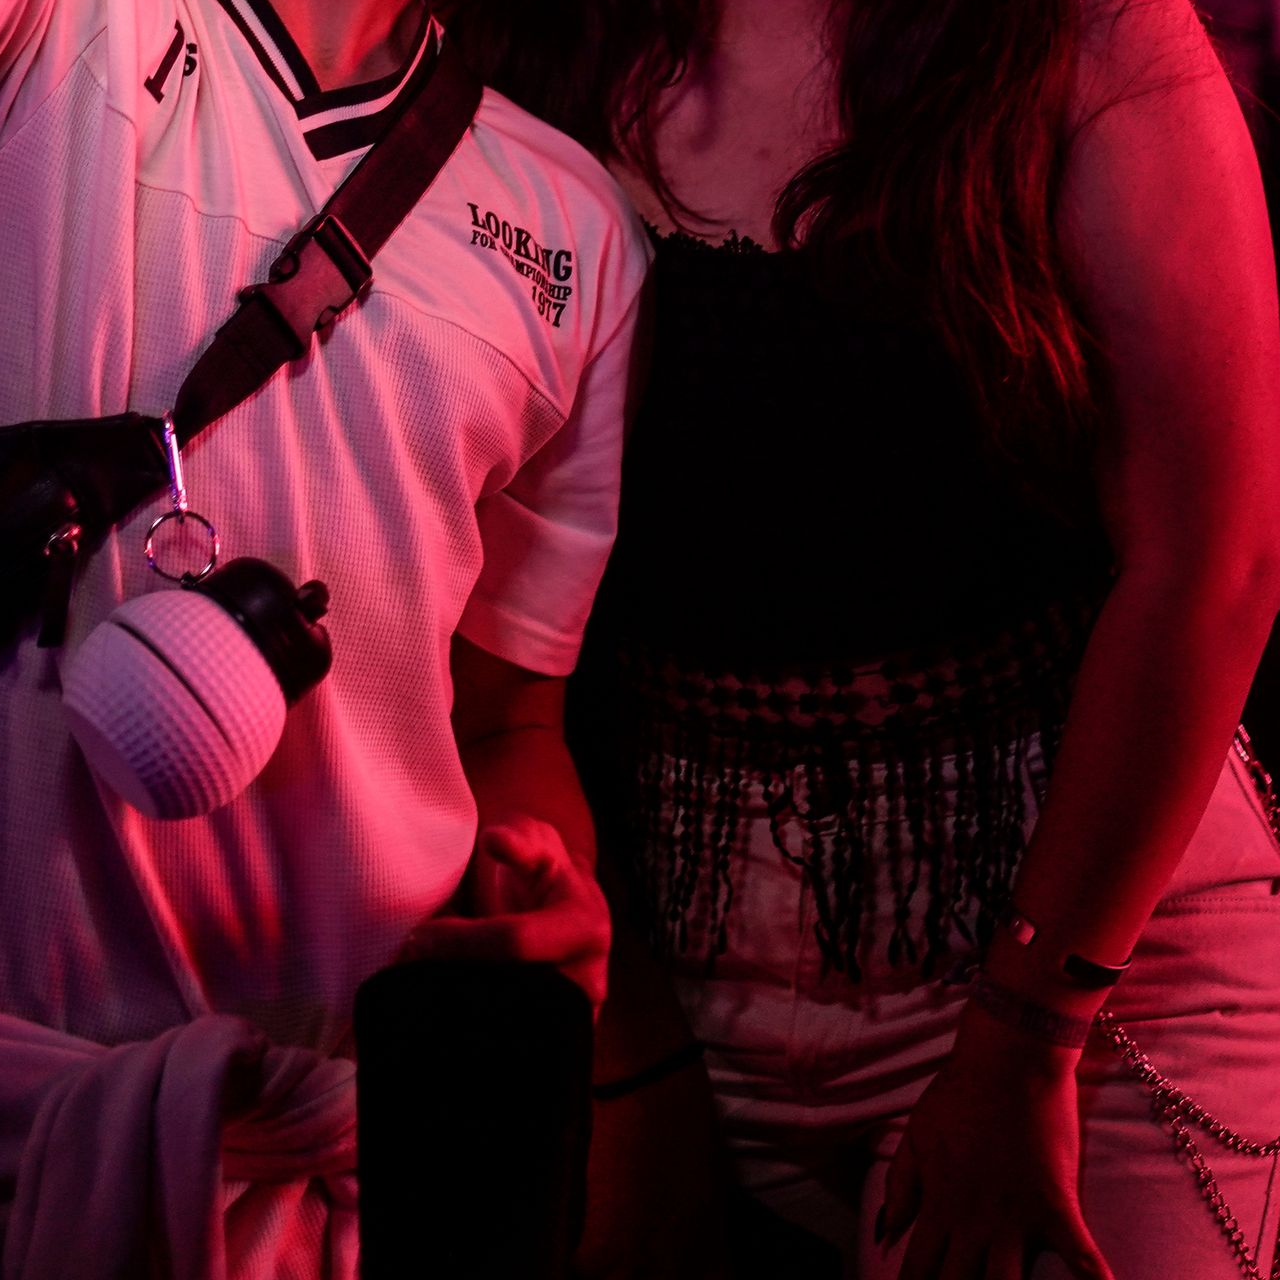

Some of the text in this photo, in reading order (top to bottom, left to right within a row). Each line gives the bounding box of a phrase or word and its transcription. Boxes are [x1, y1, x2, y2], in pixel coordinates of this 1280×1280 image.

[467, 202, 573, 282] LOOKING
[470, 229, 498, 251] FOR
[532, 286, 566, 328] 1977
